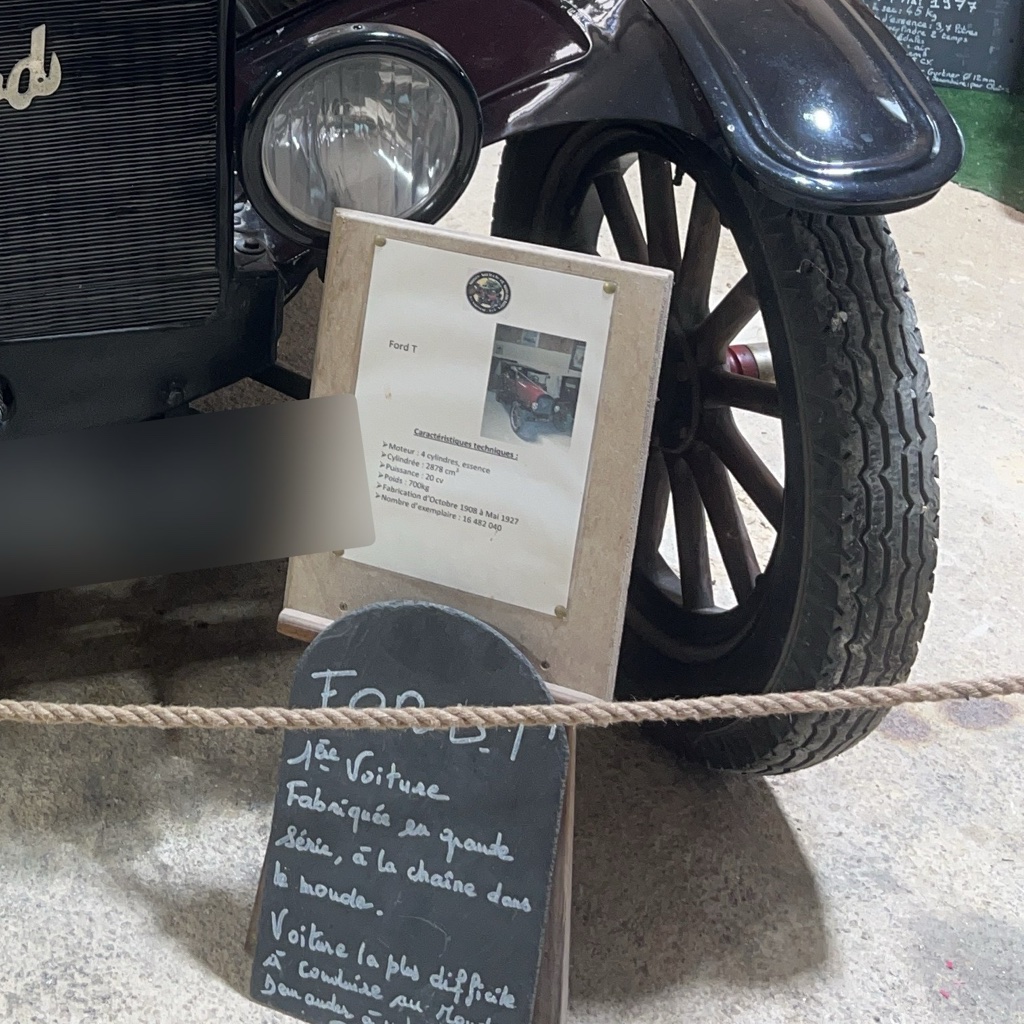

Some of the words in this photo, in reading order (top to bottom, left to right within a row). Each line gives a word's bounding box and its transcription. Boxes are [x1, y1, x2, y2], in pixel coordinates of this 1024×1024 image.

[906, 5, 923, 17] 45
[942, 32, 968, 44] temps
[388, 340, 409, 352] Ford
[411, 344, 418, 353] T
[388, 442, 415, 456] Moteur
[426, 451, 461, 467] cylindres,
[462, 462, 490, 474] essence
[414, 427, 472, 449] Caractéristiques
[474, 440, 514, 460] techniques
[385, 463, 420, 478] Puissance
[425, 473, 434, 482] 20
[387, 453, 420, 468] Cylindrée
[425, 462, 444, 473] 2878
[384, 473, 403, 485] Poids
[408, 479, 430, 492] 700kg
[381, 494, 410, 508] Nombre
[411, 501, 456, 520] d'exemplaire
[463, 515, 472, 523] 16
[473, 517, 487, 527] 482
[382, 483, 422, 500] Fabrication
[423, 494, 458, 510] d'Octobre
[460, 504, 478, 515] 1908
[485, 510, 500, 520] Mai
[501, 514, 519, 525] 1927
[346, 750, 451, 802] Voiture
[285, 779, 392, 834] Fabriquée
[398, 818, 431, 838] en
[439, 828, 515, 864] grande
[273, 860, 289, 888] le
[377, 848, 397, 874] la
[406, 859, 478, 897] chaîne
[486, 881, 532, 913] dans
[270, 908, 349, 959] Voiture
[357, 940, 380, 969] la
[385, 952, 420, 982] plus
[429, 964, 517, 1010] difficile
